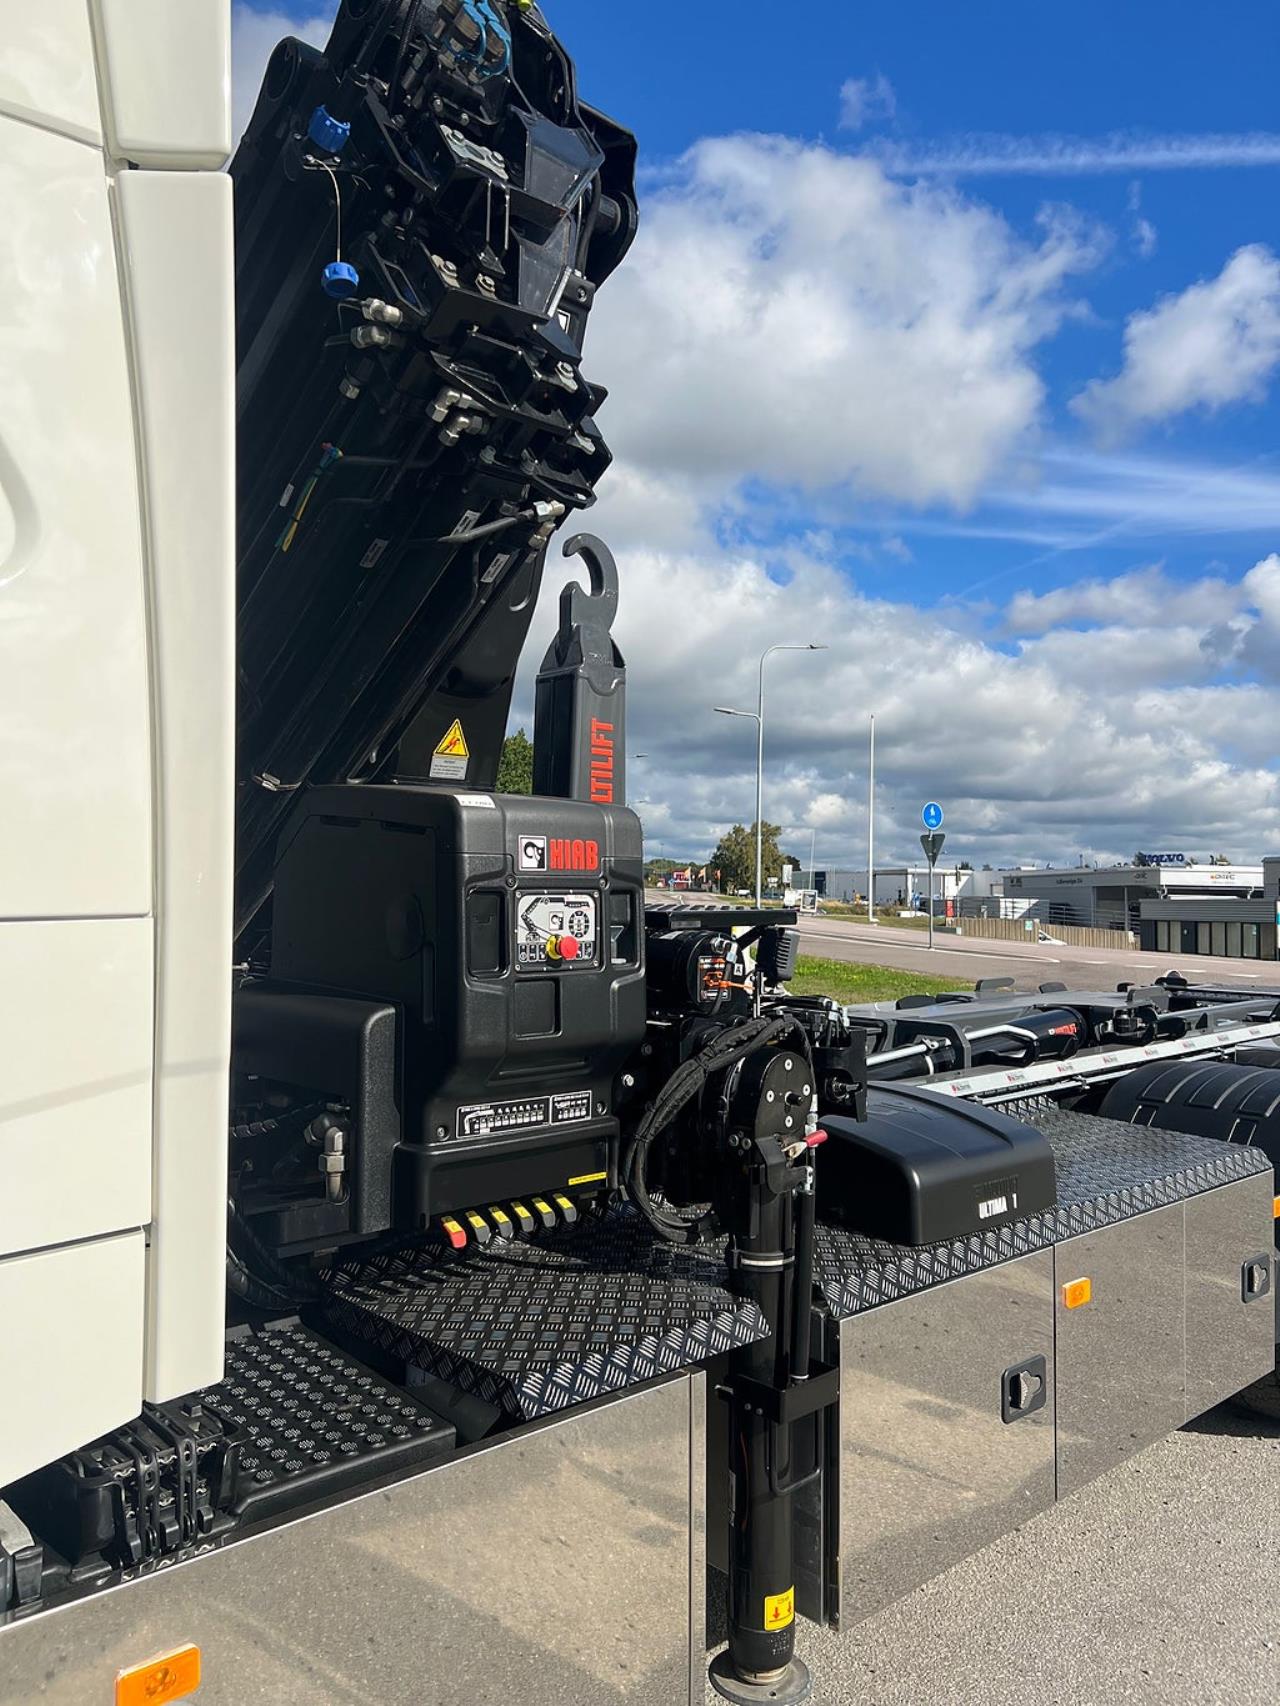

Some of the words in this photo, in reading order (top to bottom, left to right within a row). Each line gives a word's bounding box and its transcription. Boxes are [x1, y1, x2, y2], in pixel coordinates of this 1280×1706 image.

[549, 838, 599, 871] HIAB
[1143, 853, 1185, 863] VOLVO
[978, 1195, 1008, 1219] ULTIMA
[1011, 1193, 1018, 1209] 1
